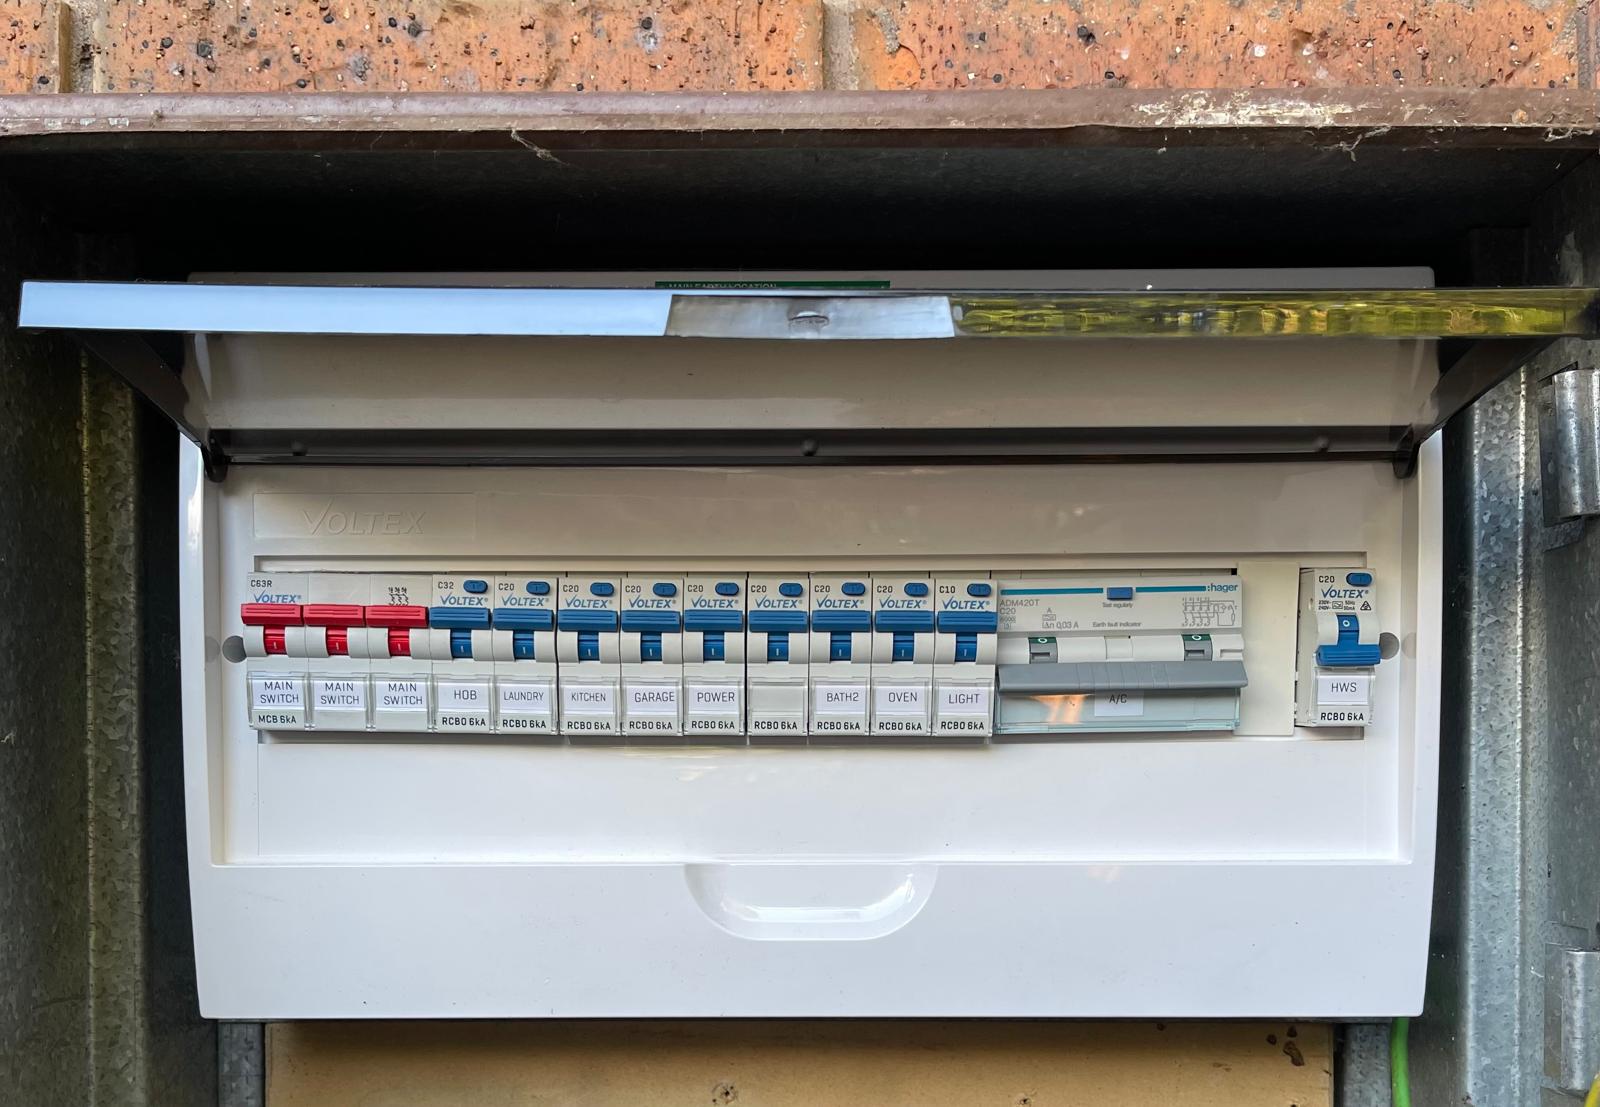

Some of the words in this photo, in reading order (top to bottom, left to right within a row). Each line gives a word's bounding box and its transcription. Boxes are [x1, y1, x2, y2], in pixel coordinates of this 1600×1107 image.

[302, 497, 426, 536] VOLTEX
[250, 580, 272, 588] C63R
[438, 582, 454, 590] C32
[498, 583, 515, 591] C20
[625, 585, 641, 593] C20
[750, 585, 767, 593] C20
[939, 586, 956, 594] C10
[264, 682, 293, 690] MAIN
[325, 682, 353, 691] MAIN
[388, 683, 417, 692] MAIN
[1331, 682, 1357, 693] HWS
[260, 694, 299, 703] SWITCH
[321, 695, 359, 704] SWITCH
[454, 690, 477, 700] HOB
[503, 691, 544, 700] LAUNDRY
[571, 693, 606, 702] KITCHEN
[634, 692, 675, 702] GARAGE
[697, 692, 735, 702] POWER
[827, 692, 859, 702] BATH2
[888, 693, 917, 702] OVEN
[949, 694, 981, 704] LIGHT
[1109, 695, 1127, 704] A/C
[383, 696, 422, 705] SWITCH
[258, 715, 278, 723] MCB
[280, 715, 296, 723] 6kA
[1321, 713, 1345, 721] RCBO
[1347, 712, 1364, 720] 6kA
[469, 718, 486, 726] 6kA
[503, 720, 527, 728] RCBO
[529, 720, 546, 728] 6kA
[594, 722, 611, 730] 6kA
[692, 721, 716, 729] RCBO
[718, 721, 735, 729] 6kA
[754, 721, 778, 729] RCBO
[781, 721, 797, 730] 6kA
[817, 722, 841, 730] RCBO
[844, 722, 860, 730] 6kA
[879, 722, 903, 730] RCBO
[906, 722, 922, 730] 6kA
[941, 722, 965, 730] RCBO
[968, 721, 984, 730] 6kA
